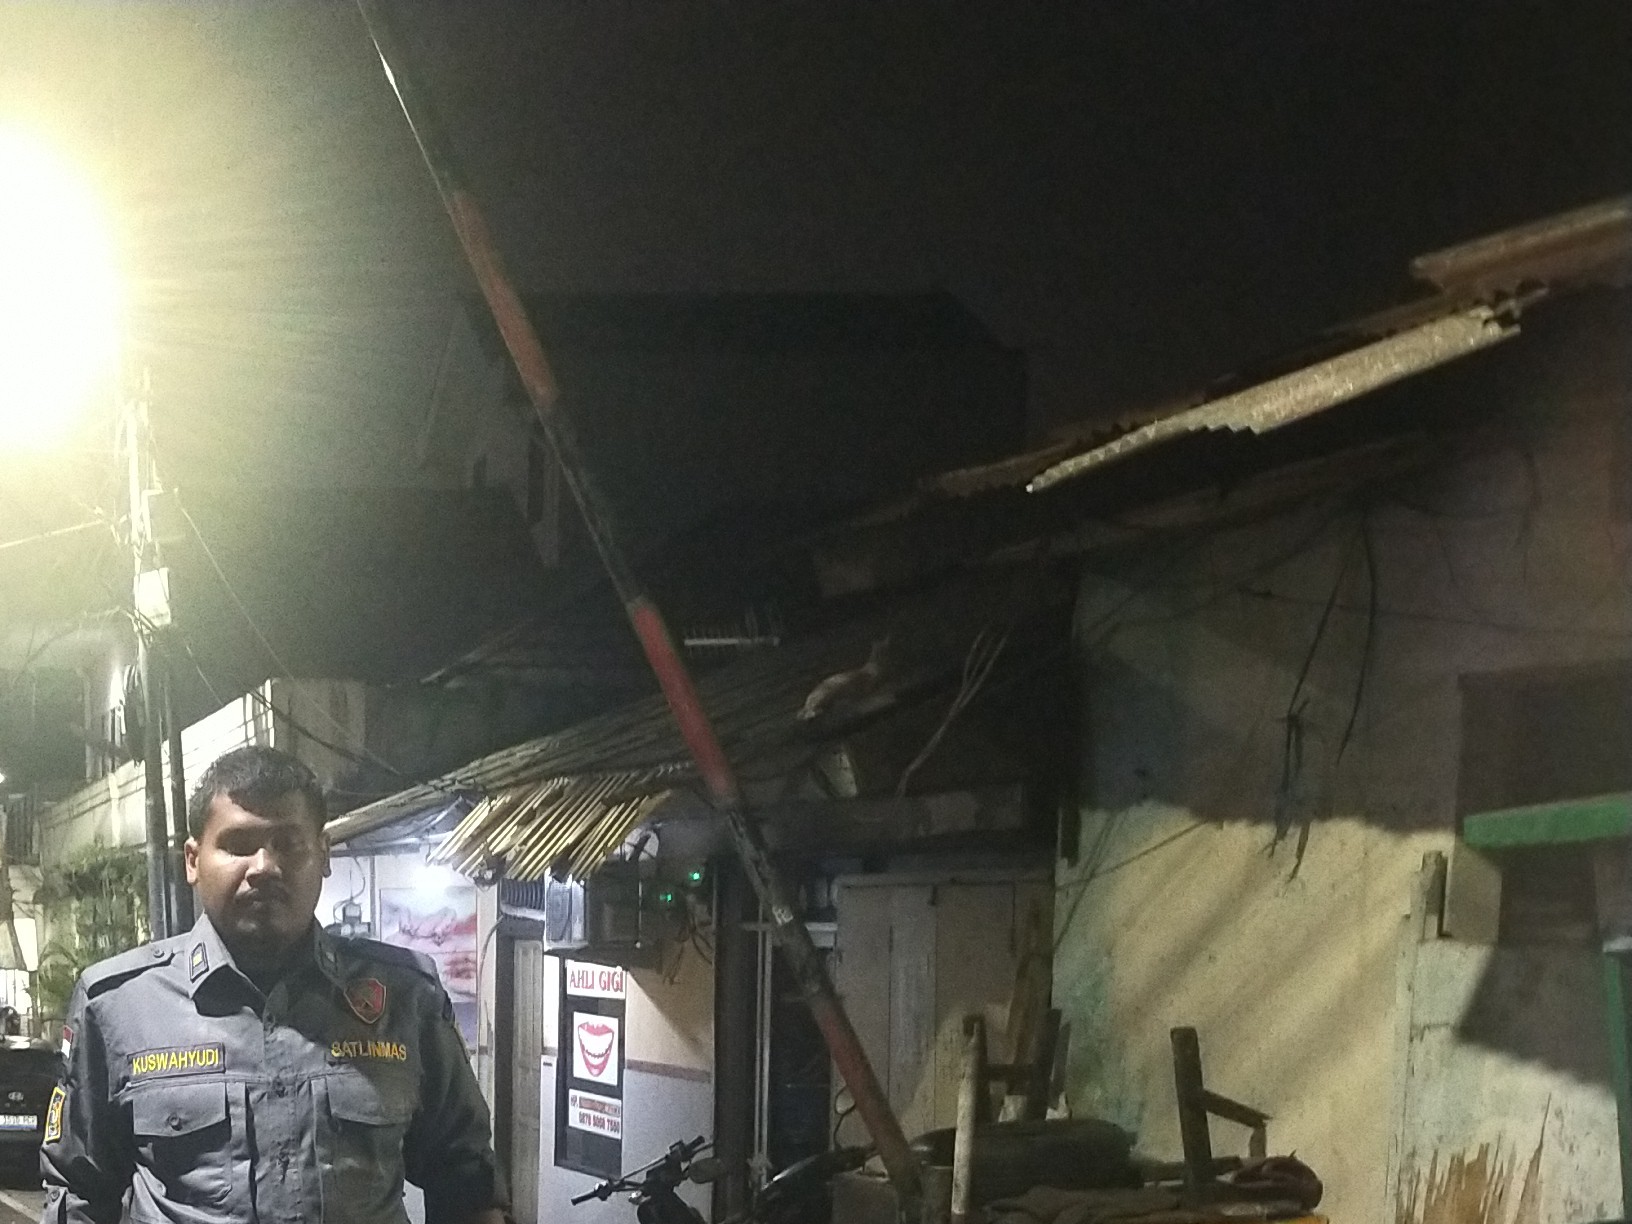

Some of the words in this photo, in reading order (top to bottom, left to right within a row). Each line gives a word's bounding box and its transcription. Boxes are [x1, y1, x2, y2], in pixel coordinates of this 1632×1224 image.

[569, 969, 595, 990] AHLI
[598, 970, 624, 993] GIGI
[132, 1047, 219, 1075] KUSWAHYUDI
[330, 1040, 407, 1061] SATLINMAS
